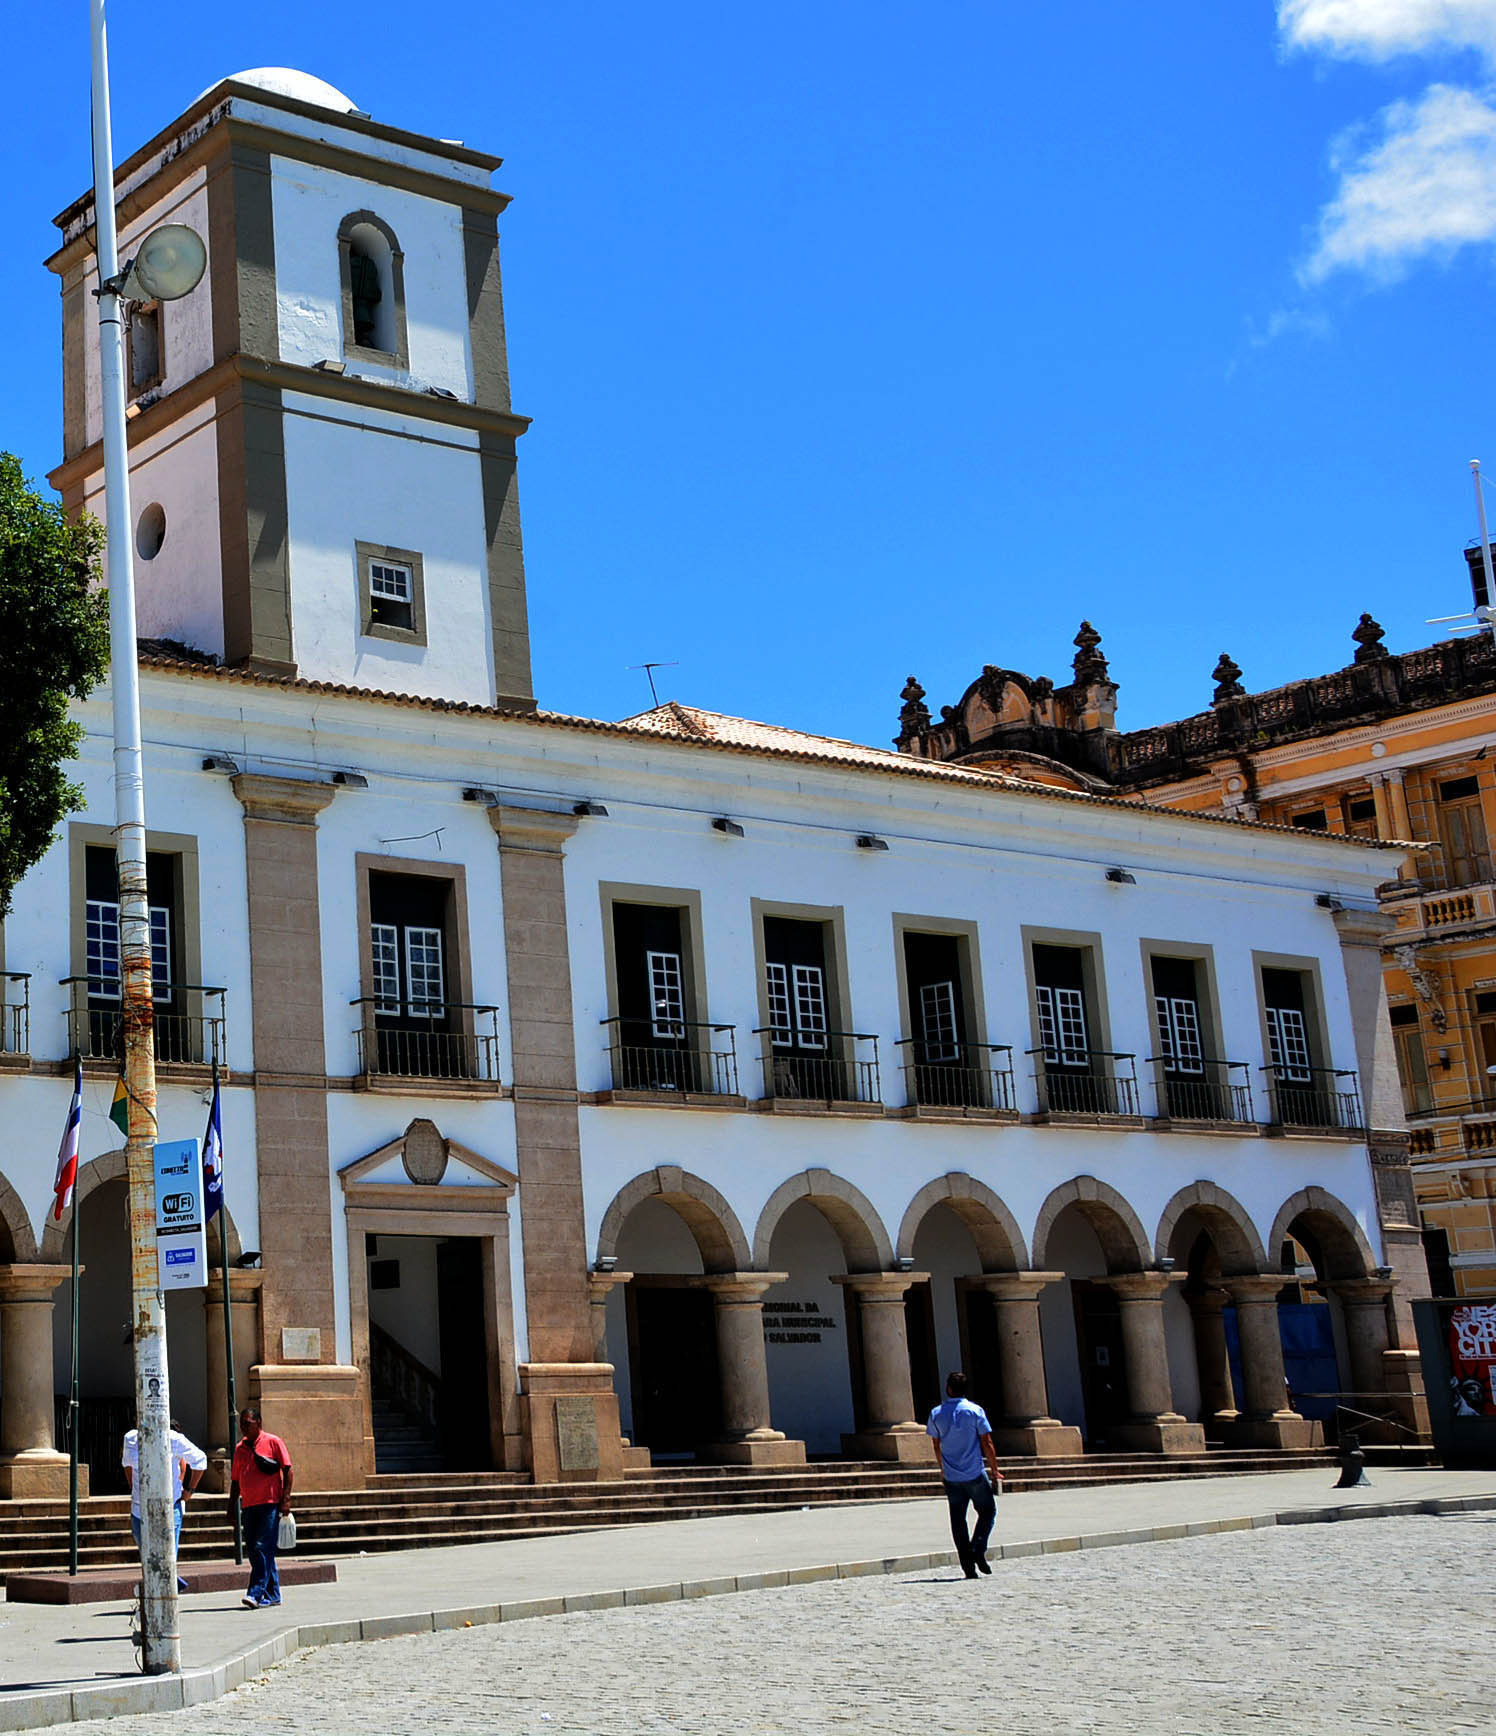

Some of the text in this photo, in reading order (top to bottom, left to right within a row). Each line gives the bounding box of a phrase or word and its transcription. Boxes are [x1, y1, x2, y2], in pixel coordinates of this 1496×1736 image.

[163, 1214, 194, 1224] GRATUITO
[762, 1302, 820, 1312] MORIAL DA
[782, 1317, 836, 1328] MUNICIPAL
[1451, 1321, 1496, 1338] YOR
[769, 1332, 821, 1343] SALVADOR
[1458, 1336, 1496, 1356] CIT
